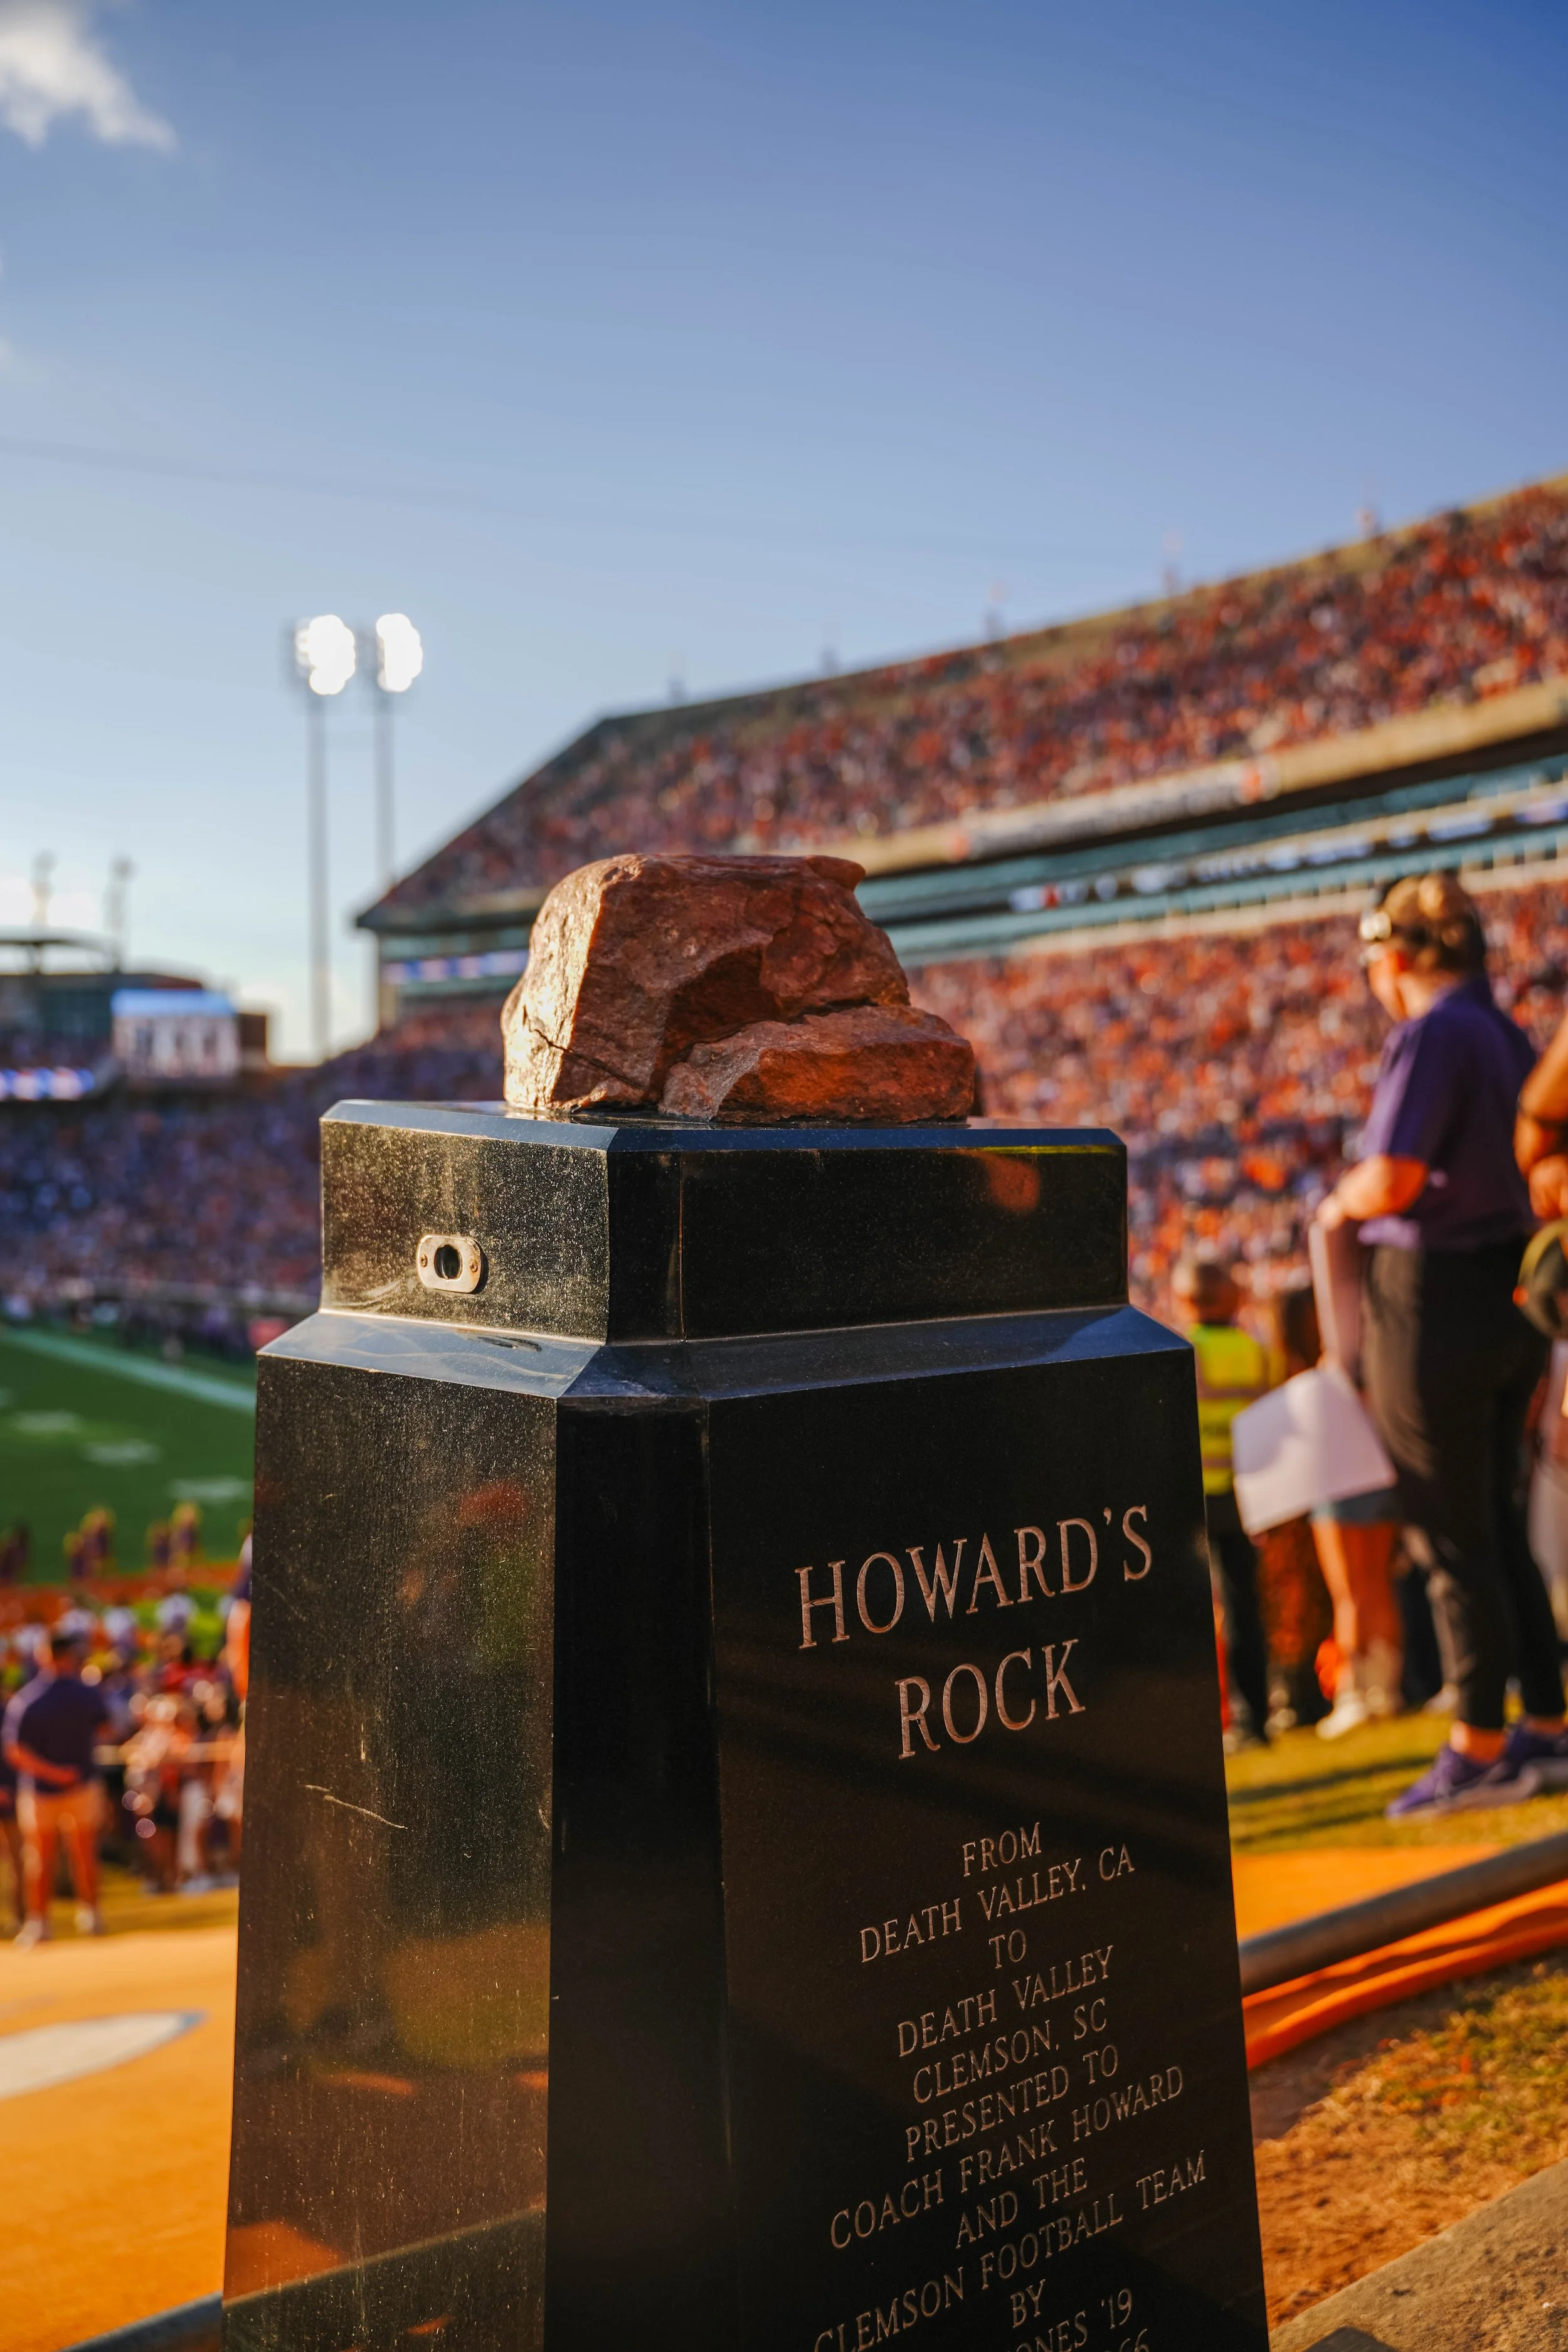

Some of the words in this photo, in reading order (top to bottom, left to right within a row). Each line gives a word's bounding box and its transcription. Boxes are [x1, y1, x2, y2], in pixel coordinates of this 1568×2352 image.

[795, 1505, 1152, 1649] HOWARD'S
[895, 1639, 1086, 1759] ROCK
[859, 1899, 962, 1963] DEATH
[1099, 1844, 1135, 1880] CA
[962, 1822, 1042, 1877] FROM
[897, 1989, 997, 2057] DEATH
[1012, 1946, 1114, 2010] VALLEY
[988, 1929, 1027, 1969] TO
[1074, 1998, 1106, 2040] SC
[830, 2169, 944, 2249] COACH
[960, 2120, 1058, 2193] FRANK
[1072, 2066, 1184, 2141] HOWARD
[906, 2065, 1069, 2162] PRESENTED
[1083, 2044, 1118, 2084] TO
[814, 2266, 964, 2352] CLEMSON
[980, 2194, 1123, 2290] FOOTBALL
[1136, 2150, 1206, 2210] TEAM
[956, 2191, 1018, 2249] AND
[1033, 2157, 1089, 2208] THE
[1010, 2279, 1046, 2328] BY
[1101, 2288, 1132, 2329] '19
